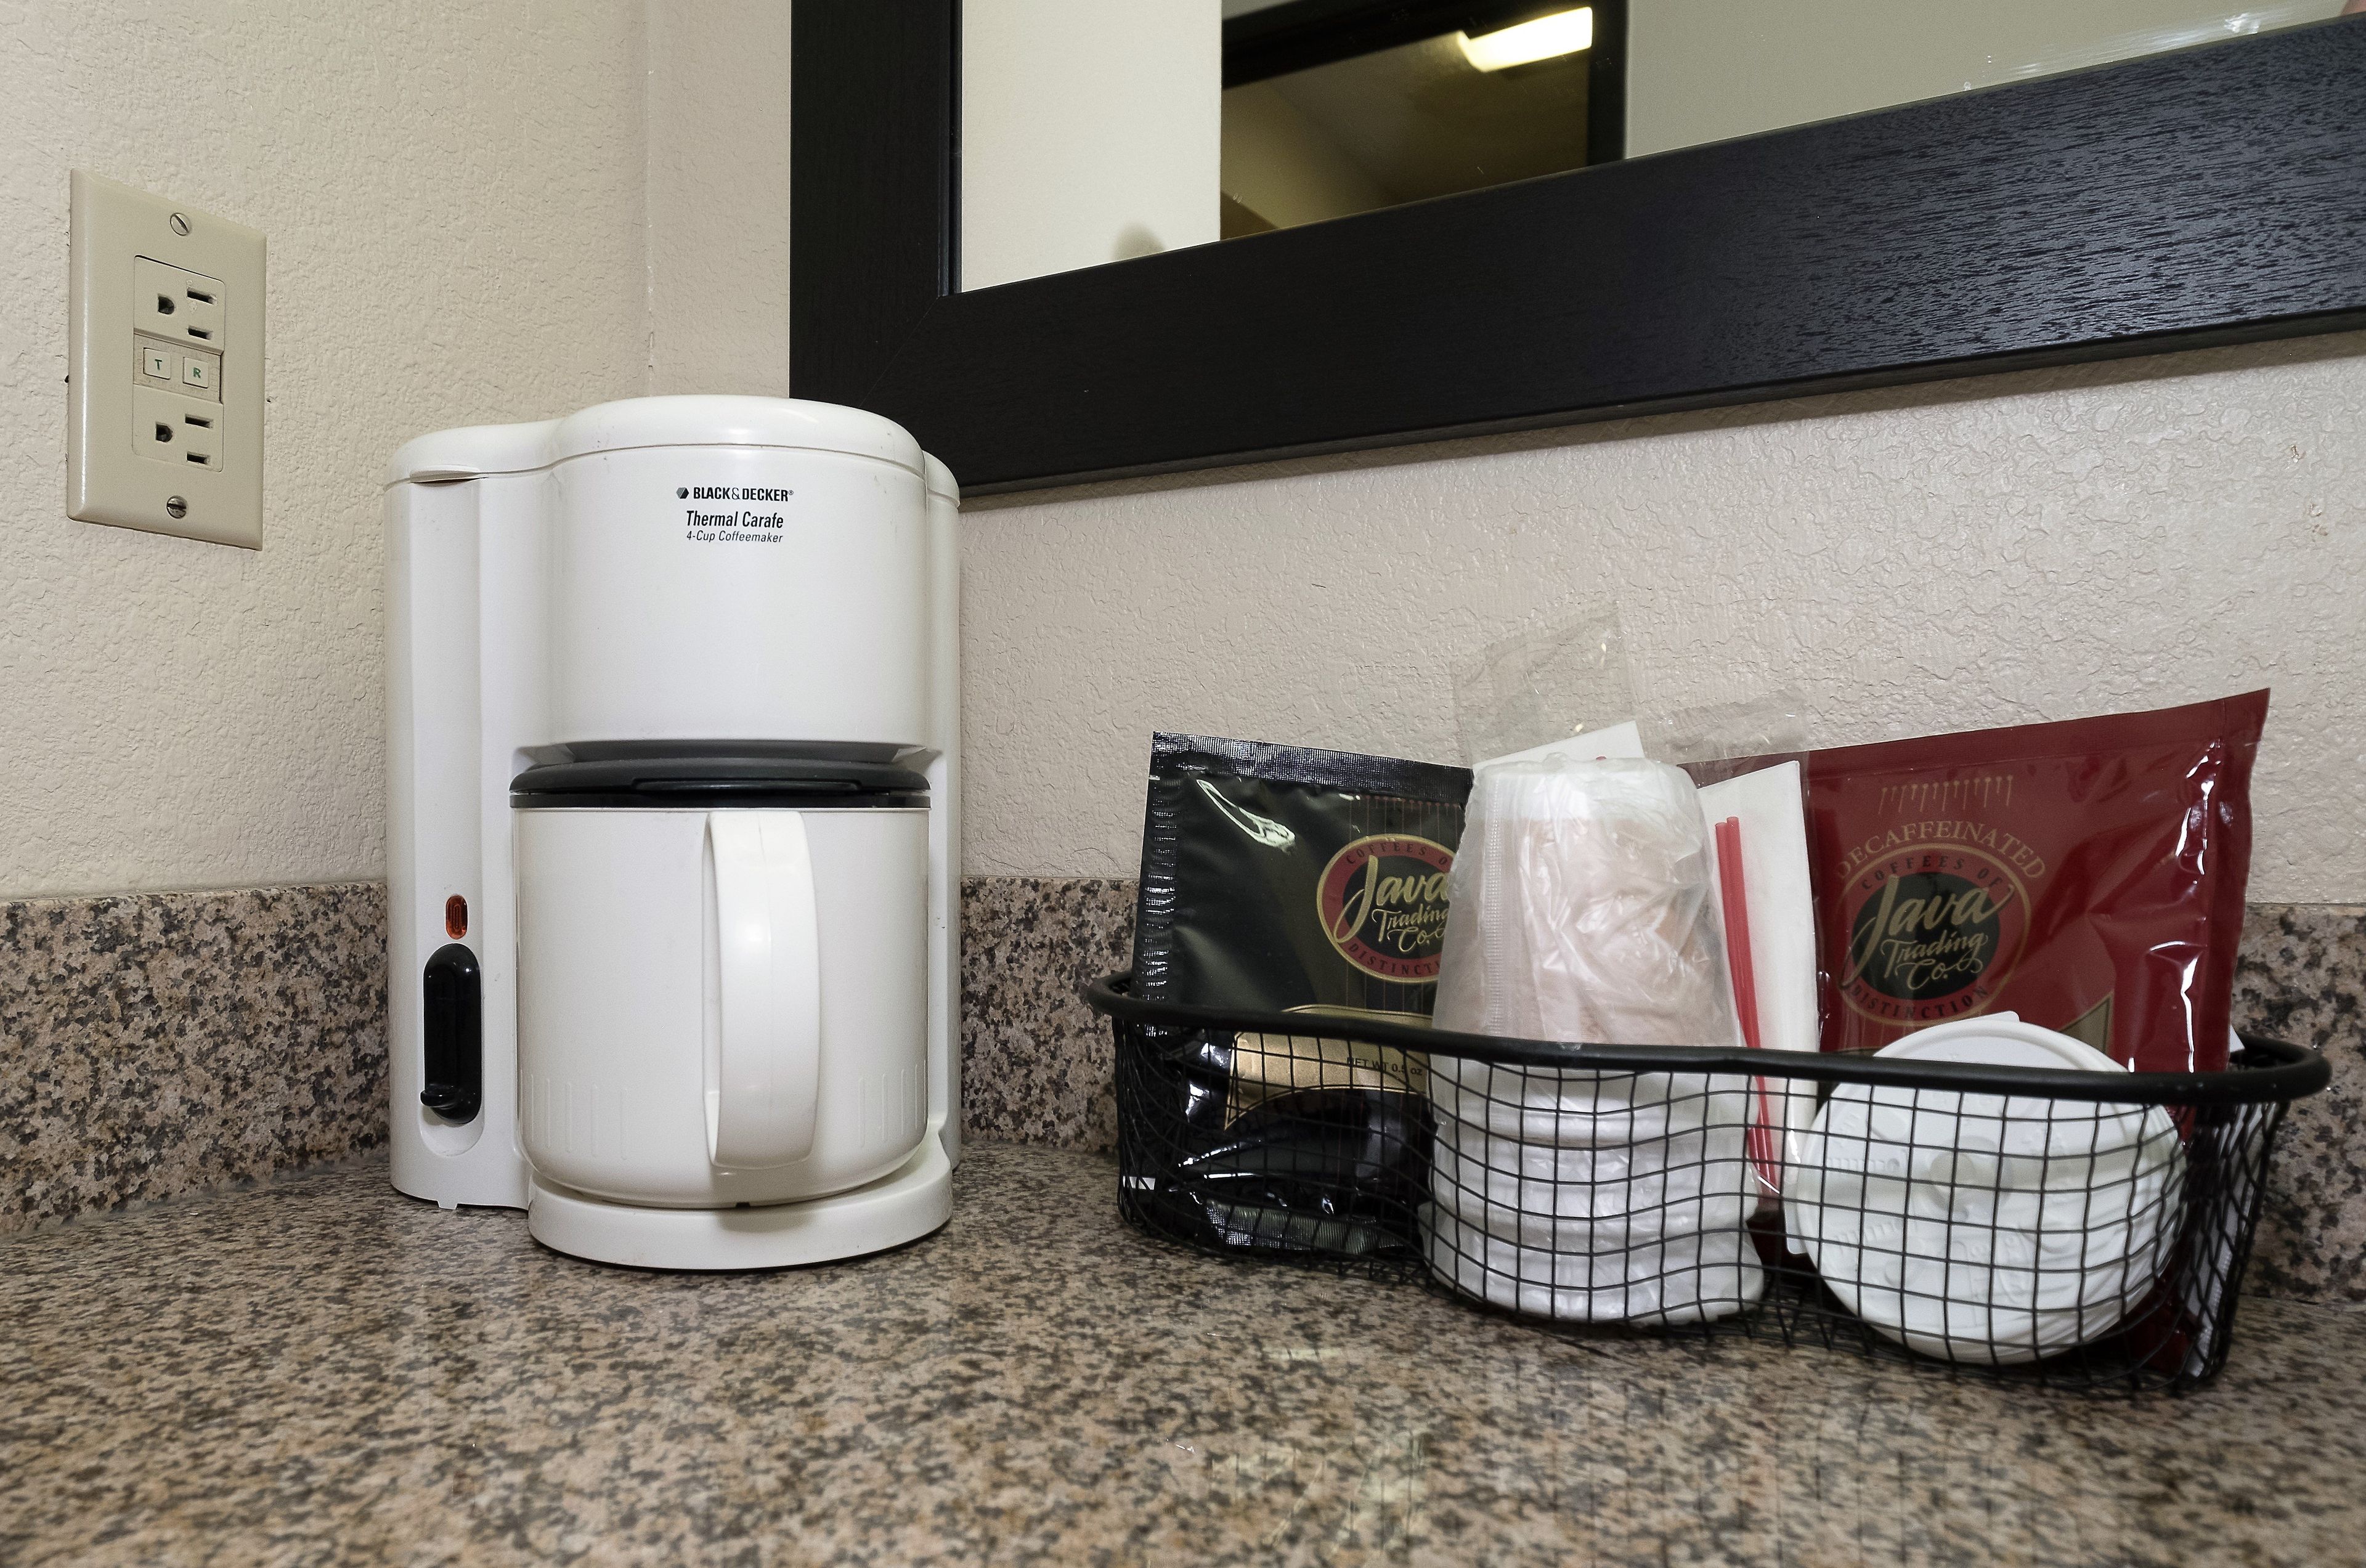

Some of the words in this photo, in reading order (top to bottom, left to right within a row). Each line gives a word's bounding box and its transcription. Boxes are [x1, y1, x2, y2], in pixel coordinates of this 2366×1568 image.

[154, 359, 163, 371] T
[193, 367, 201, 379] R
[686, 510, 738, 527] Thermal
[742, 511, 784, 528] Carafe
[686, 530, 715, 542] 4-Cup
[718, 530, 784, 543] Coffeemaker
[1347, 842, 1426, 864] COFFEES
[1838, 820, 2046, 879] DECAFFEINATED
[1861, 855, 1964, 890] COFFEES
[1977, 868, 2002, 888] OF
[1333, 855, 1449, 943] Java
[1842, 875, 2015, 986] Java
[1881, 930, 1989, 978] Trading
[1850, 985, 1988, 1020] DISTINCTION
